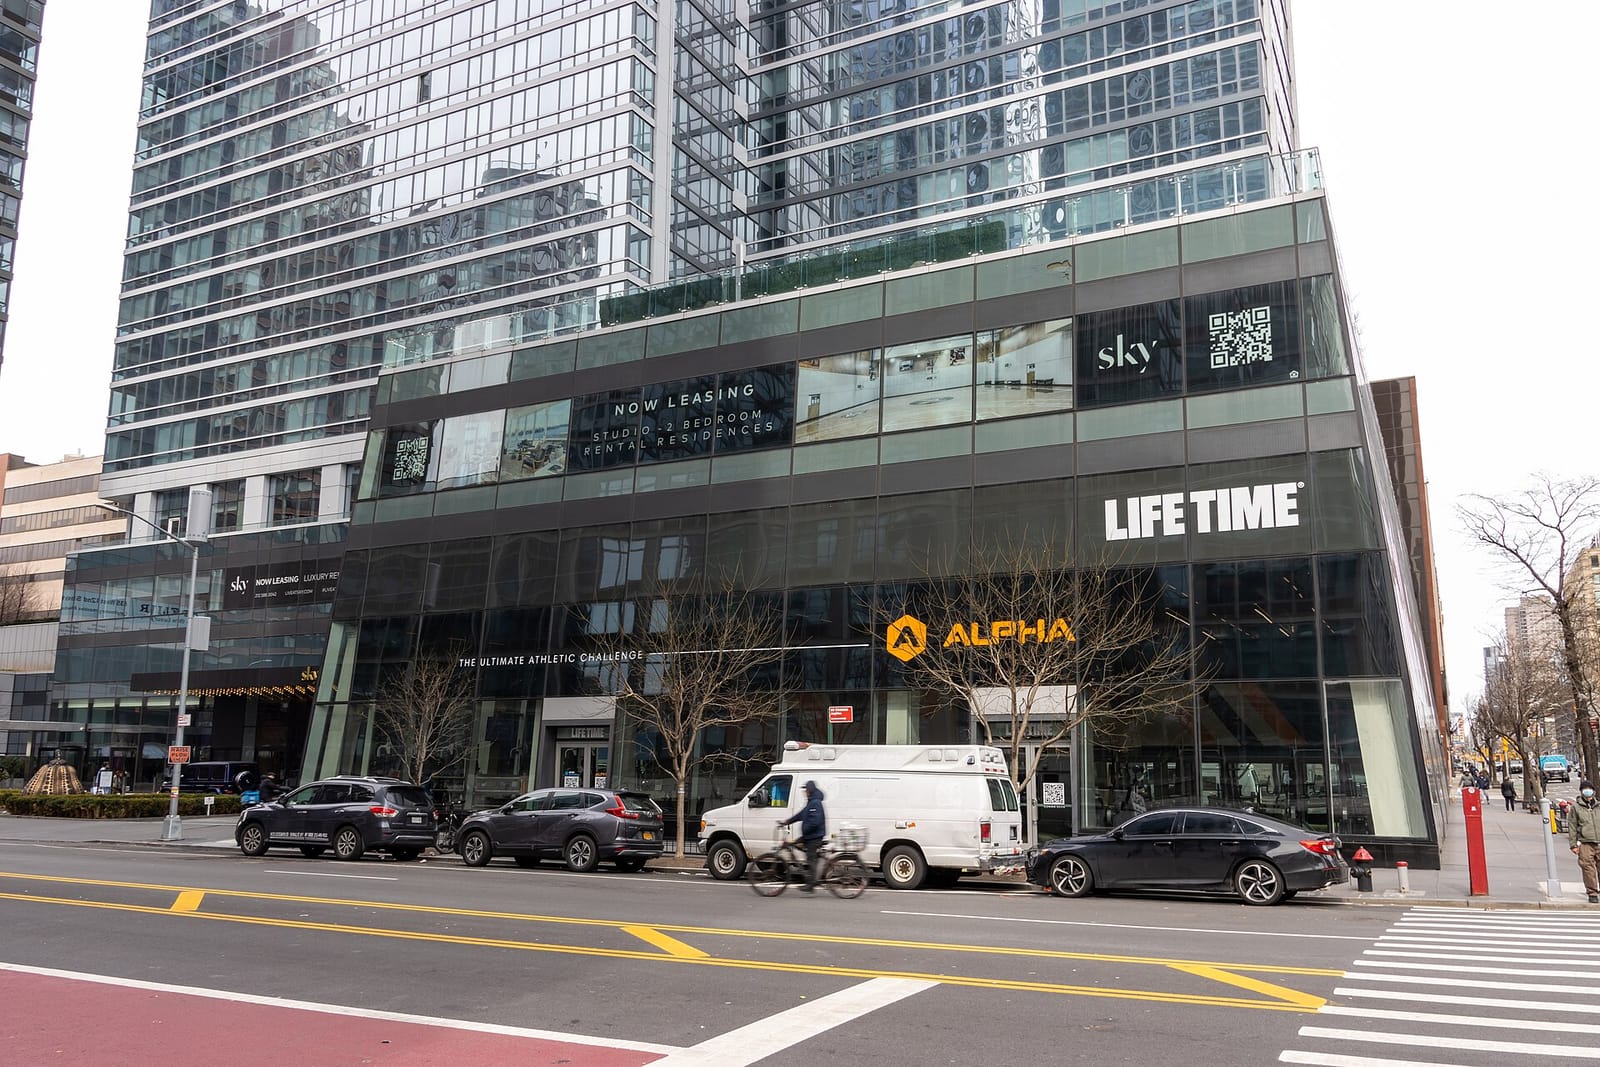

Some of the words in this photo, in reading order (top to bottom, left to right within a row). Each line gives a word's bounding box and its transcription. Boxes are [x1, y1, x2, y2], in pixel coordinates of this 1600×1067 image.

[1098, 333, 1157, 374] sky
[614, 399, 658, 416] NOW
[668, 384, 754, 408] LEASING
[583, 440, 647, 456] RENTAL
[657, 422, 774, 447] RESIDENCES
[593, 426, 650, 442] STUDIO
[683, 409, 762, 430] BEDROOM
[1104, 492, 1186, 541] LIFE
[230, 576, 249, 595] sky
[255, 578, 272, 586] NOW
[272, 575, 299, 585] LEASING
[303, 573, 329, 582] LUXURY
[943, 617, 1077, 648] ALPHA
[459, 658, 476, 667] THE
[480, 656, 525, 666] ULTIMATE
[528, 653, 576, 664] ATHLETIC
[580, 650, 643, 663] CHALLENGE
